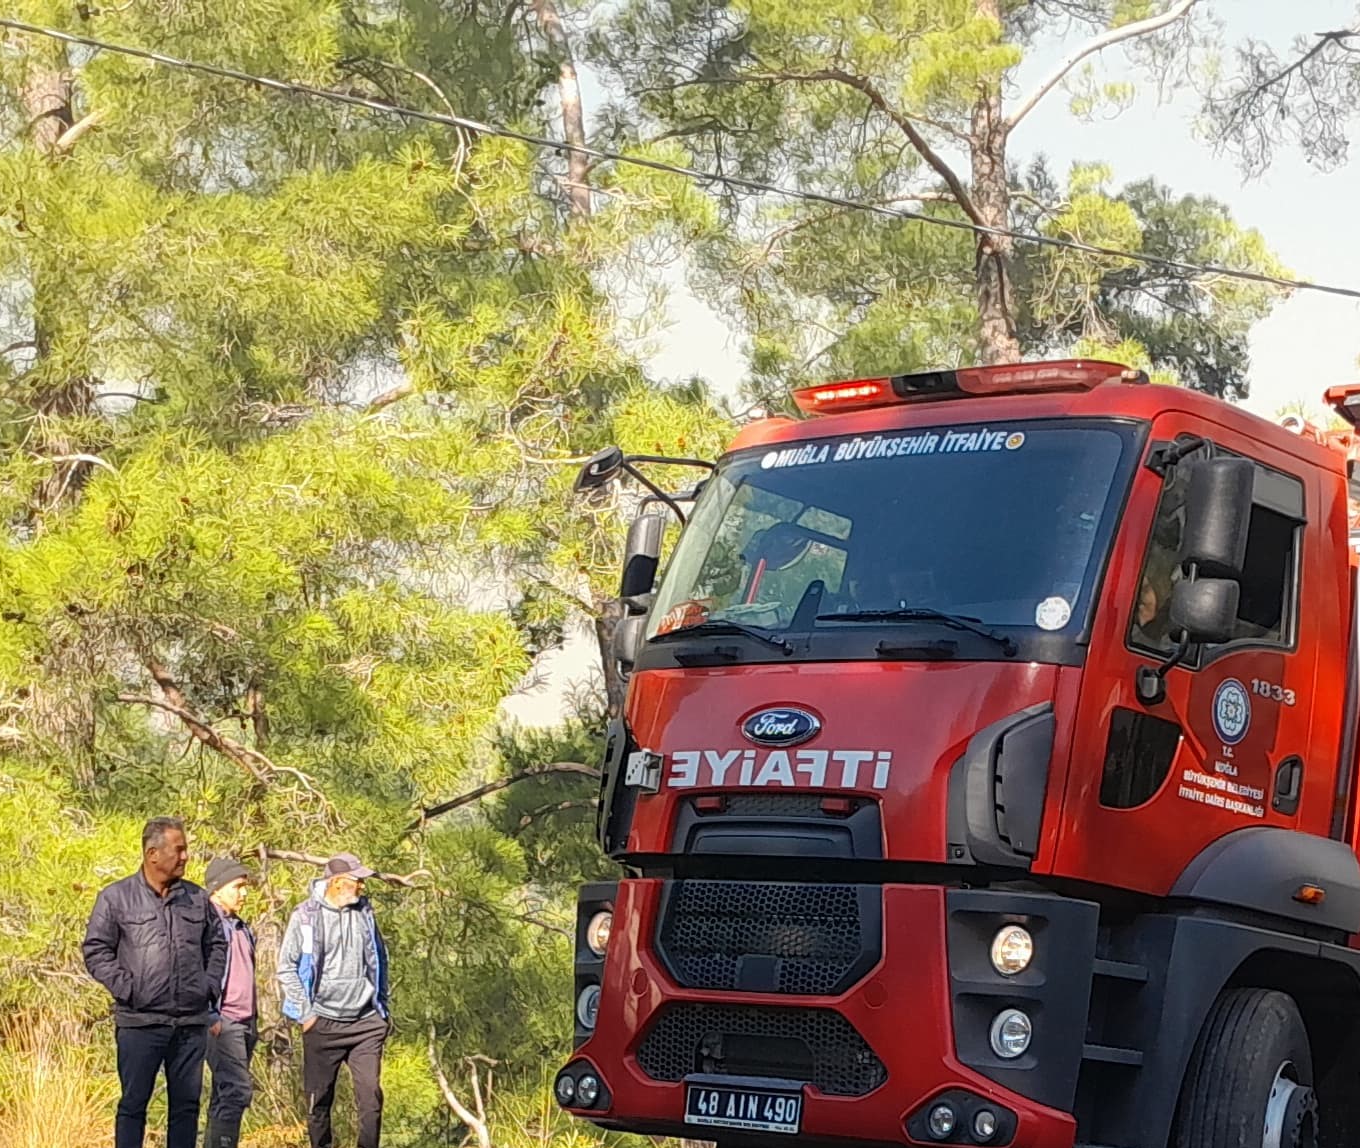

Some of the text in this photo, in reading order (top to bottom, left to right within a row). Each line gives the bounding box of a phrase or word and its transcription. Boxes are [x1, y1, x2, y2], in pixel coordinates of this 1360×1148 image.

[774, 428, 1008, 468] MUĞLA BÜYÜKŞEHİR İTFAİYE
[1250, 678, 1296, 706] 1833
[754, 712, 797, 736] Ford
[698, 1090, 797, 1122] 48 AIN 490
